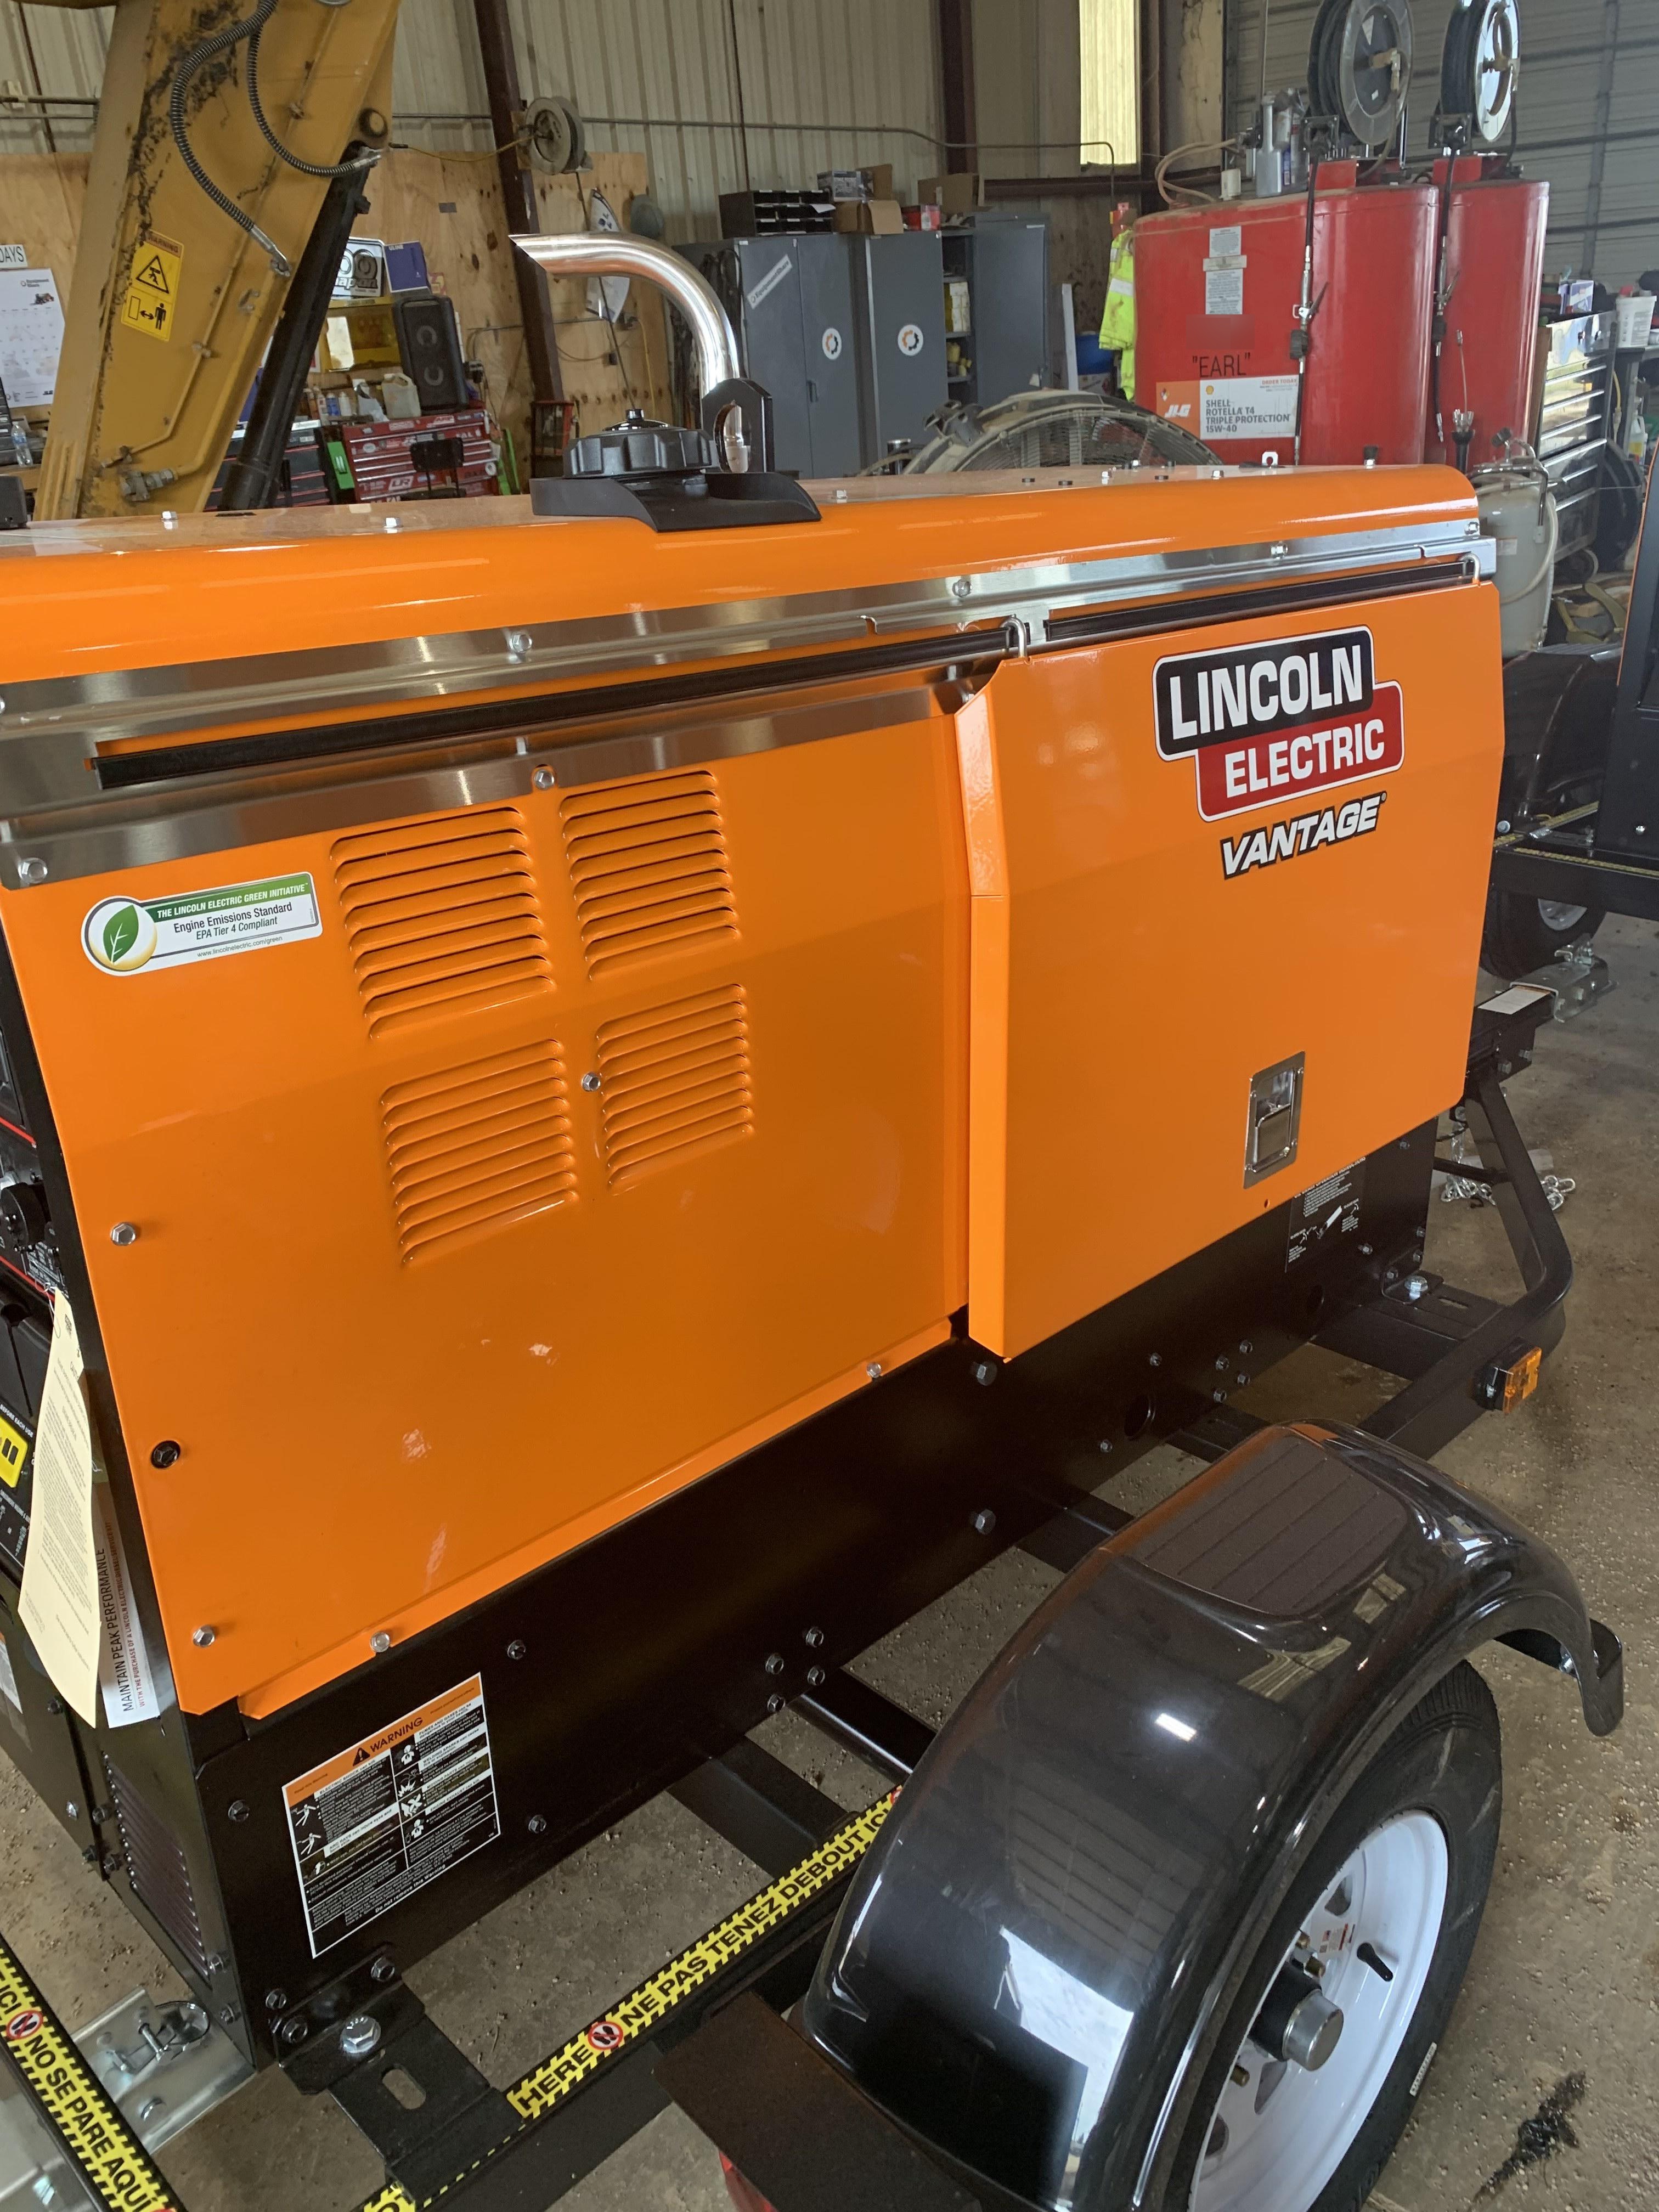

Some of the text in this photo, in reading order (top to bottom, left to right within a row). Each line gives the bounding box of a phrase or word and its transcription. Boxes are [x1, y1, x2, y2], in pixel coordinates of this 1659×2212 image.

[1192, 352, 1251, 378] "EARL"
[1164, 404, 1191, 419] JLG
[1206, 399, 1231, 408] SHELL
[1245, 407, 1255, 415] T4
[1205, 424, 1238, 433] 15W-40
[1206, 414, 1290, 425] TRIPLE PROTECTION
[1169, 644, 1363, 740] LINCOLN
[1224, 719, 1385, 798] ELECTRIC
[1221, 794, 1384, 879] VANTAGE
[157, 884, 305, 919] THE LINCOLN ELECTRIC GREEN INITIATIVE
[173, 920, 205, 933] Engine
[207, 911, 252, 927] Emissions
[253, 901, 292, 918] Standard
[196, 916, 278, 940] EPA Tier 4 Compliant
[197, 936, 283, 957] www.lincolnelectric.com/green
[122, 1607, 132, 1633] LINCOLN
[109, 1630, 124, 1660] PEAK
[129, 1647, 140, 1678] PURCHASE
[114, 1660, 134, 1712] MAINTAIN
[370, 1715, 423, 1754] WARNING
[419, 1724, 434, 1736] FUMES
[434, 1718, 443, 1727] AND
[443, 1709, 458, 1721] GASES
[375, 1862, 445, 1915] Do not remove this Warning
[622, 1991, 661, 2027] NE
[659, 1955, 709, 1997] PAS
[710, 1897, 784, 1957] TENEZ
[778, 1830, 865, 1901] DEBOUT
[517, 2041, 595, 2110] HERE
[24, 2035, 57, 2070] NO
[46, 2069, 77, 2101] SE
[65, 2096, 116, 2159] PARE
